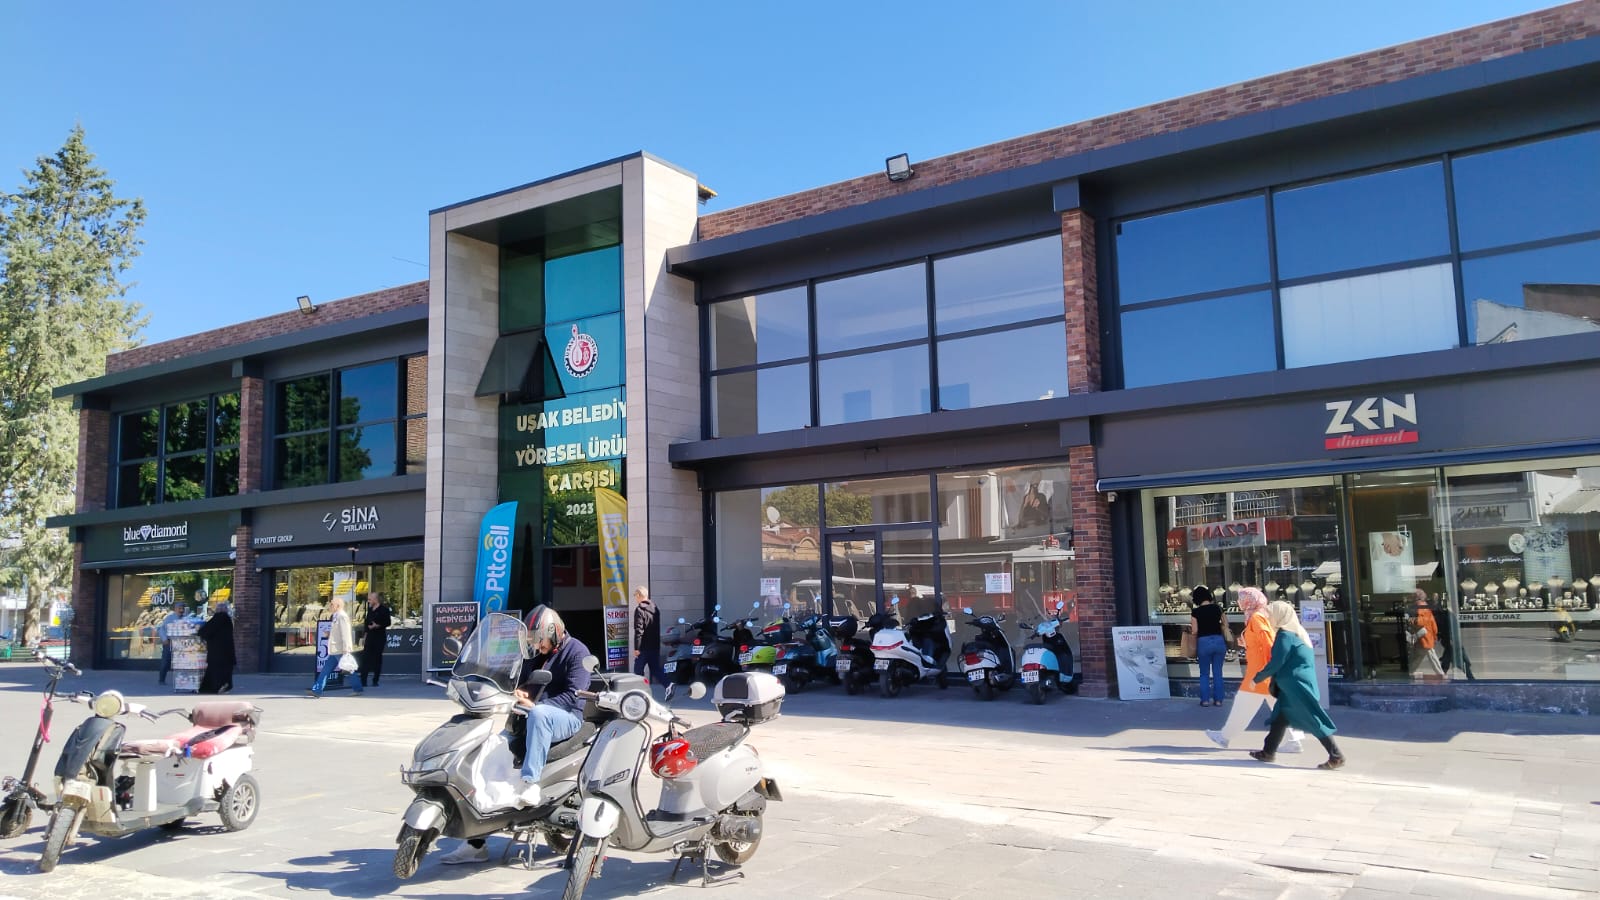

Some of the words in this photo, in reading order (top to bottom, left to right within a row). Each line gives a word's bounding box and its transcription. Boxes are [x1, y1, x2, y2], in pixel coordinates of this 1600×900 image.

[516, 411, 560, 433] UŞAK
[1325, 393, 1417, 434] ZEN
[1336, 429, 1405, 447] diamond
[515, 443, 585, 467] YÖRESEL
[548, 469, 615, 494] ÇARŞISI
[341, 506, 379, 524] SİNA
[566, 503, 594, 516] 2023
[123, 527, 141, 541] blue
[151, 521, 188, 538] diamond
[343, 523, 376, 532] PIRLANTA
[486, 525, 510, 592] Pttcell
[1491, 612, 1521, 620] OLMAZ
